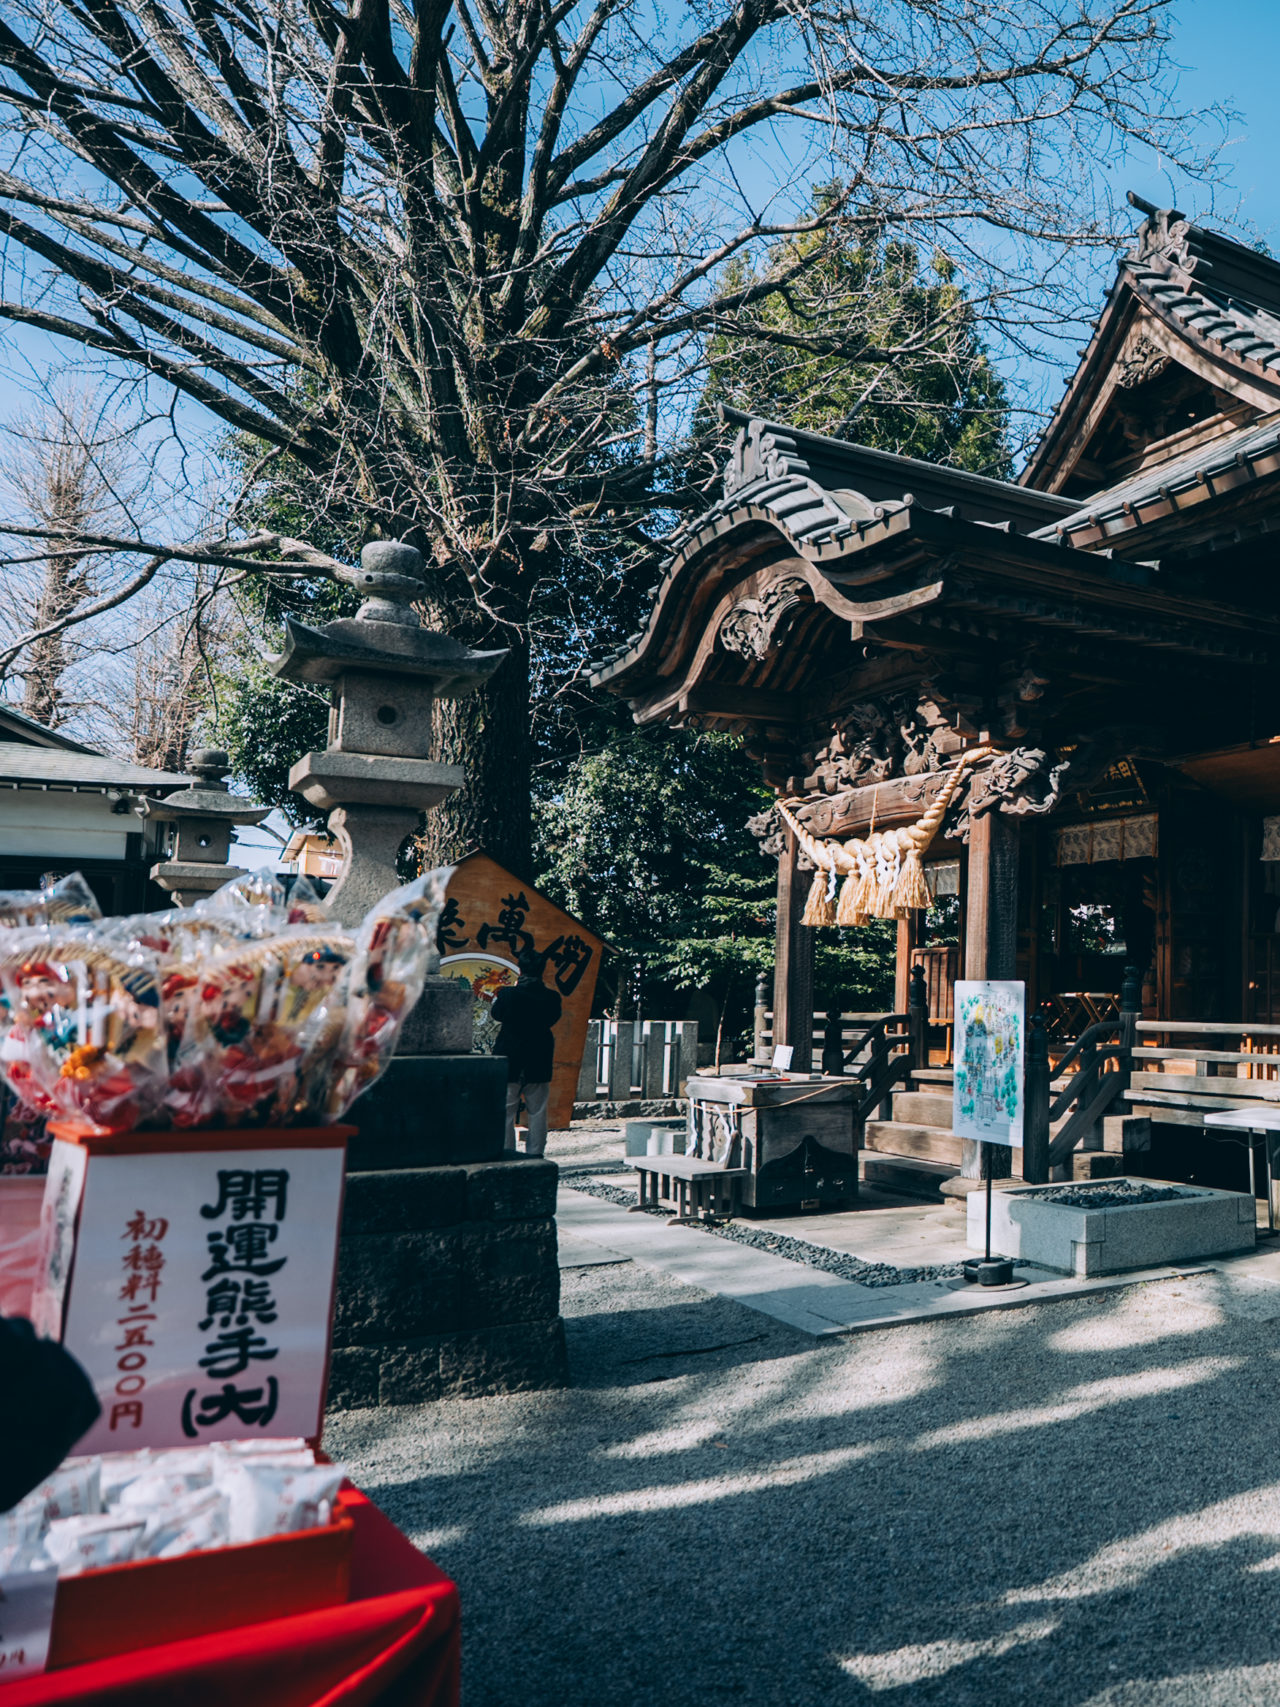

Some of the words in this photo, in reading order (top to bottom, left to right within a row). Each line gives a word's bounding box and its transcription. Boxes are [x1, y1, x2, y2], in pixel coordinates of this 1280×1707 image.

[181, 1169, 290, 1438] 開運熊手(大)
